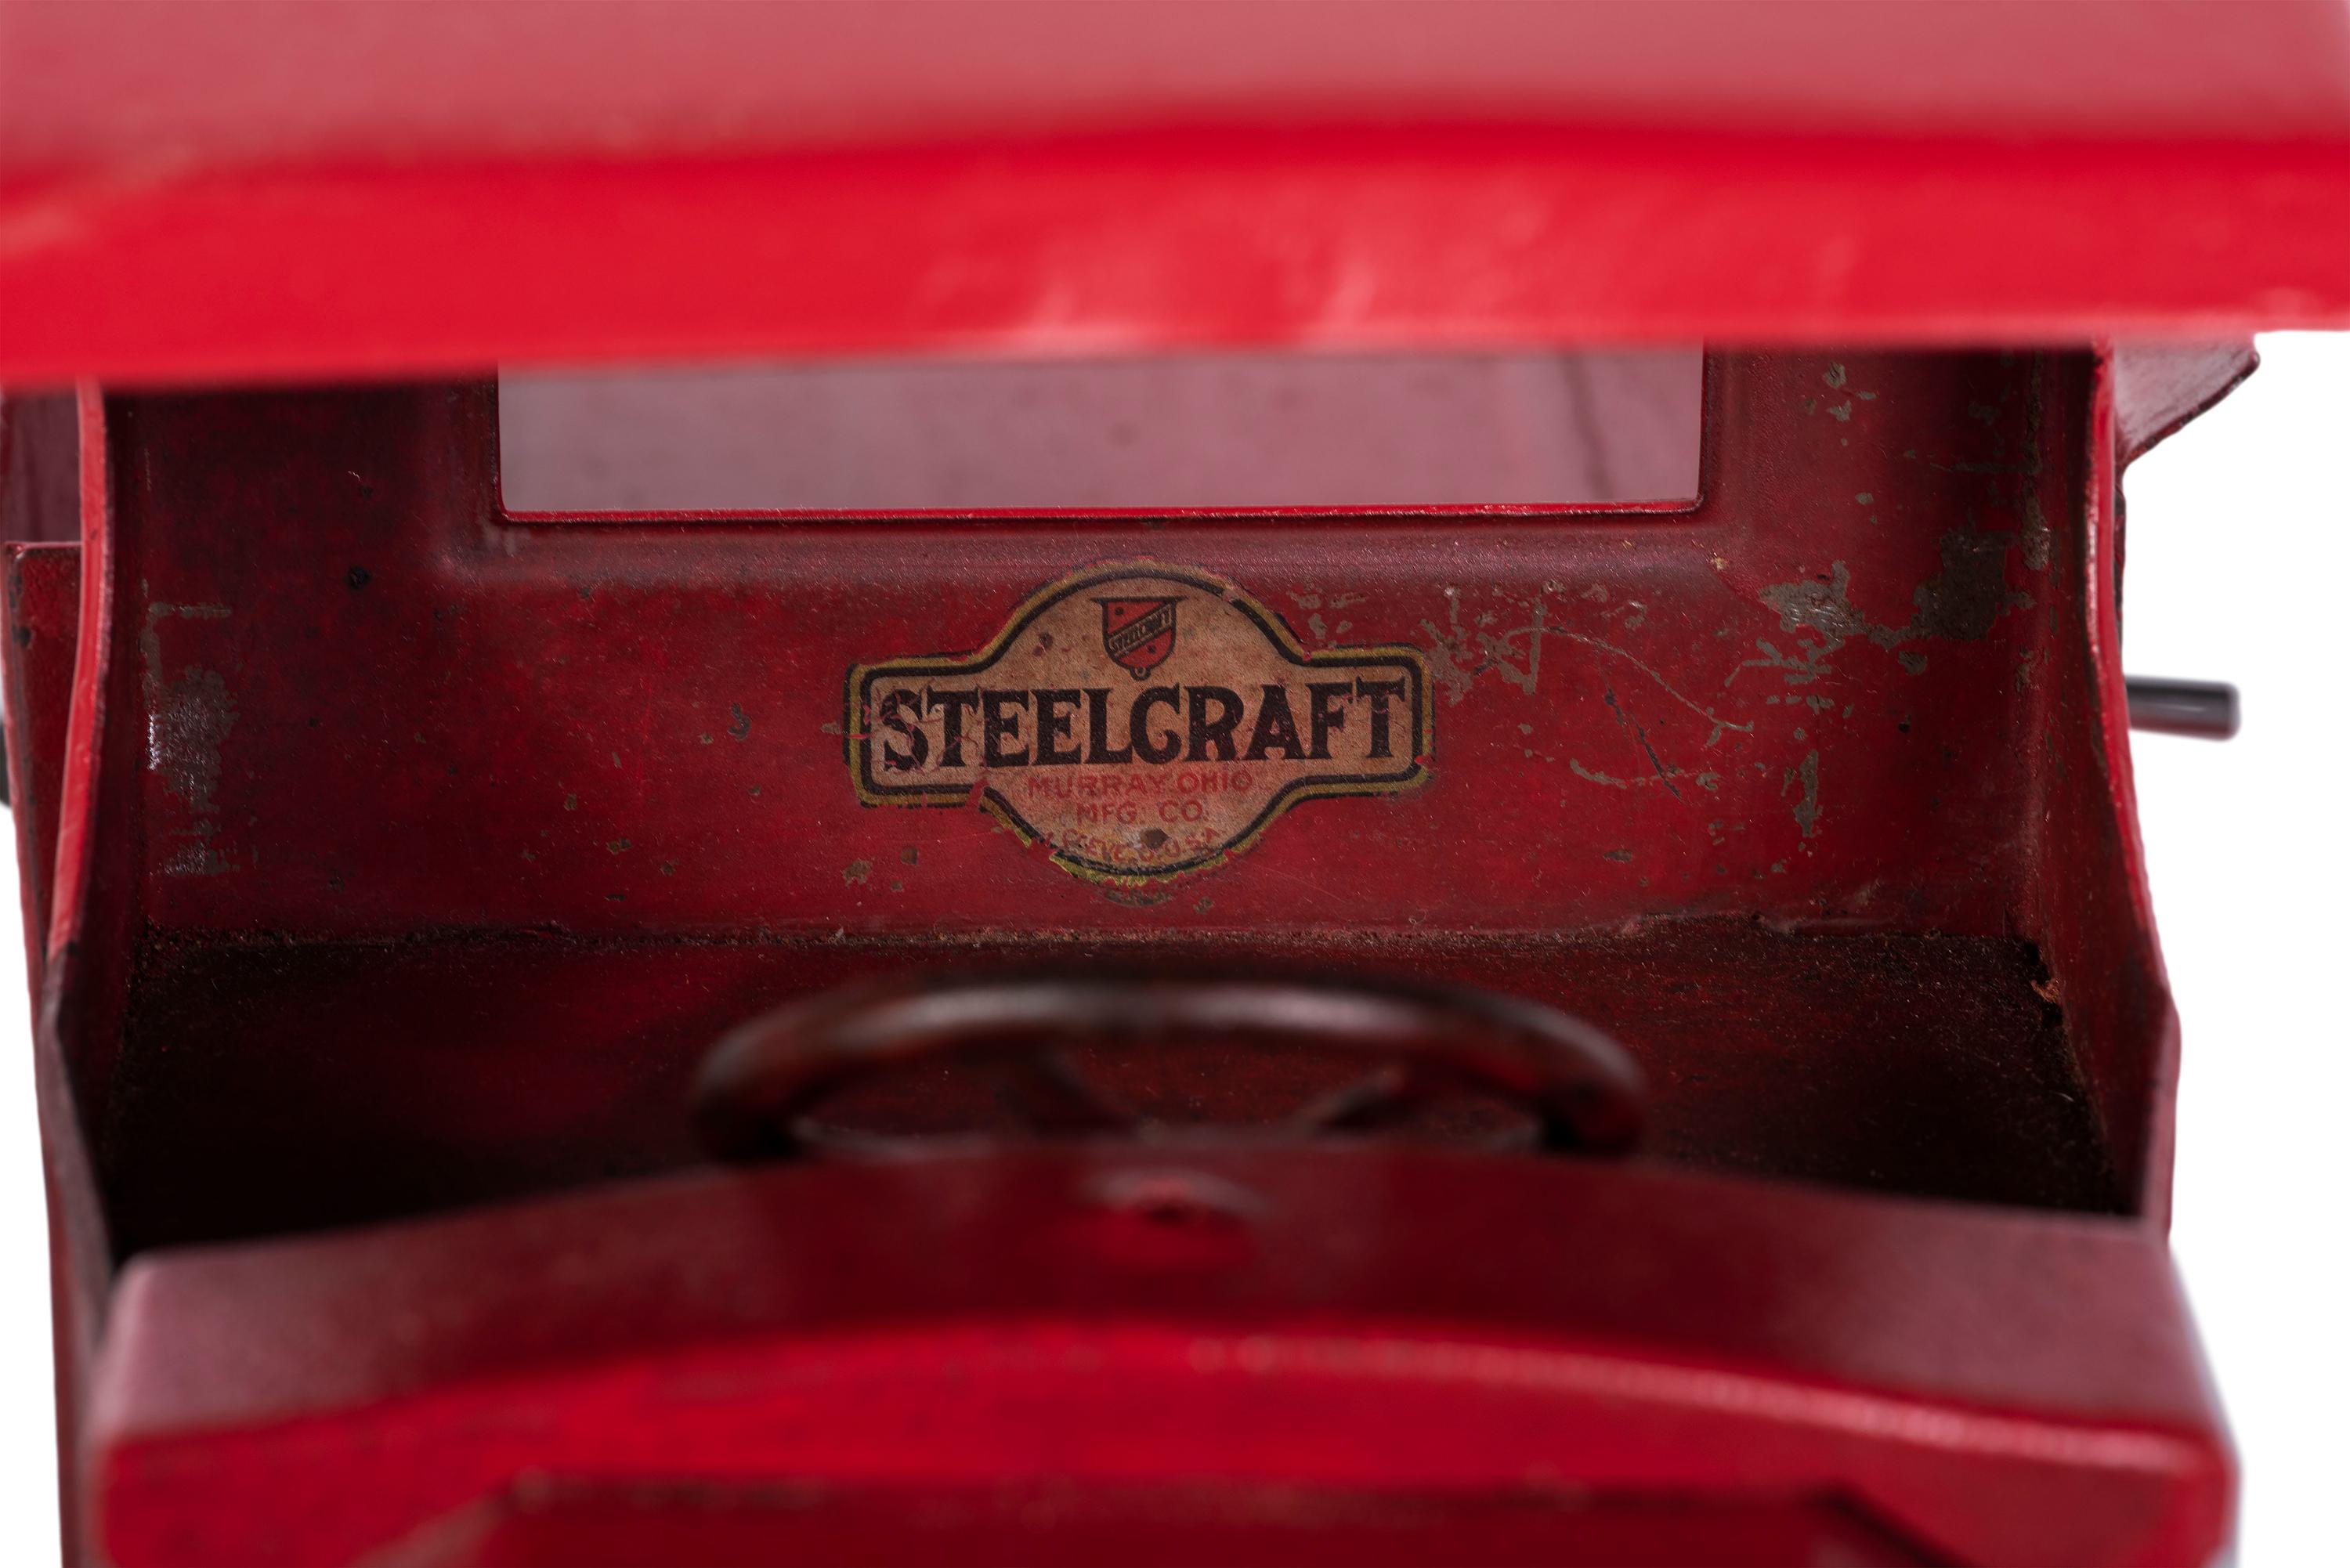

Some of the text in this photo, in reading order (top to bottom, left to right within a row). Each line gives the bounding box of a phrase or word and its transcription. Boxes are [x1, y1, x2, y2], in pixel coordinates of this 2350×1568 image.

[884, 677, 1407, 771] STEELCRAFT
[1028, 770, 1253, 799] MURRAY OHIO
